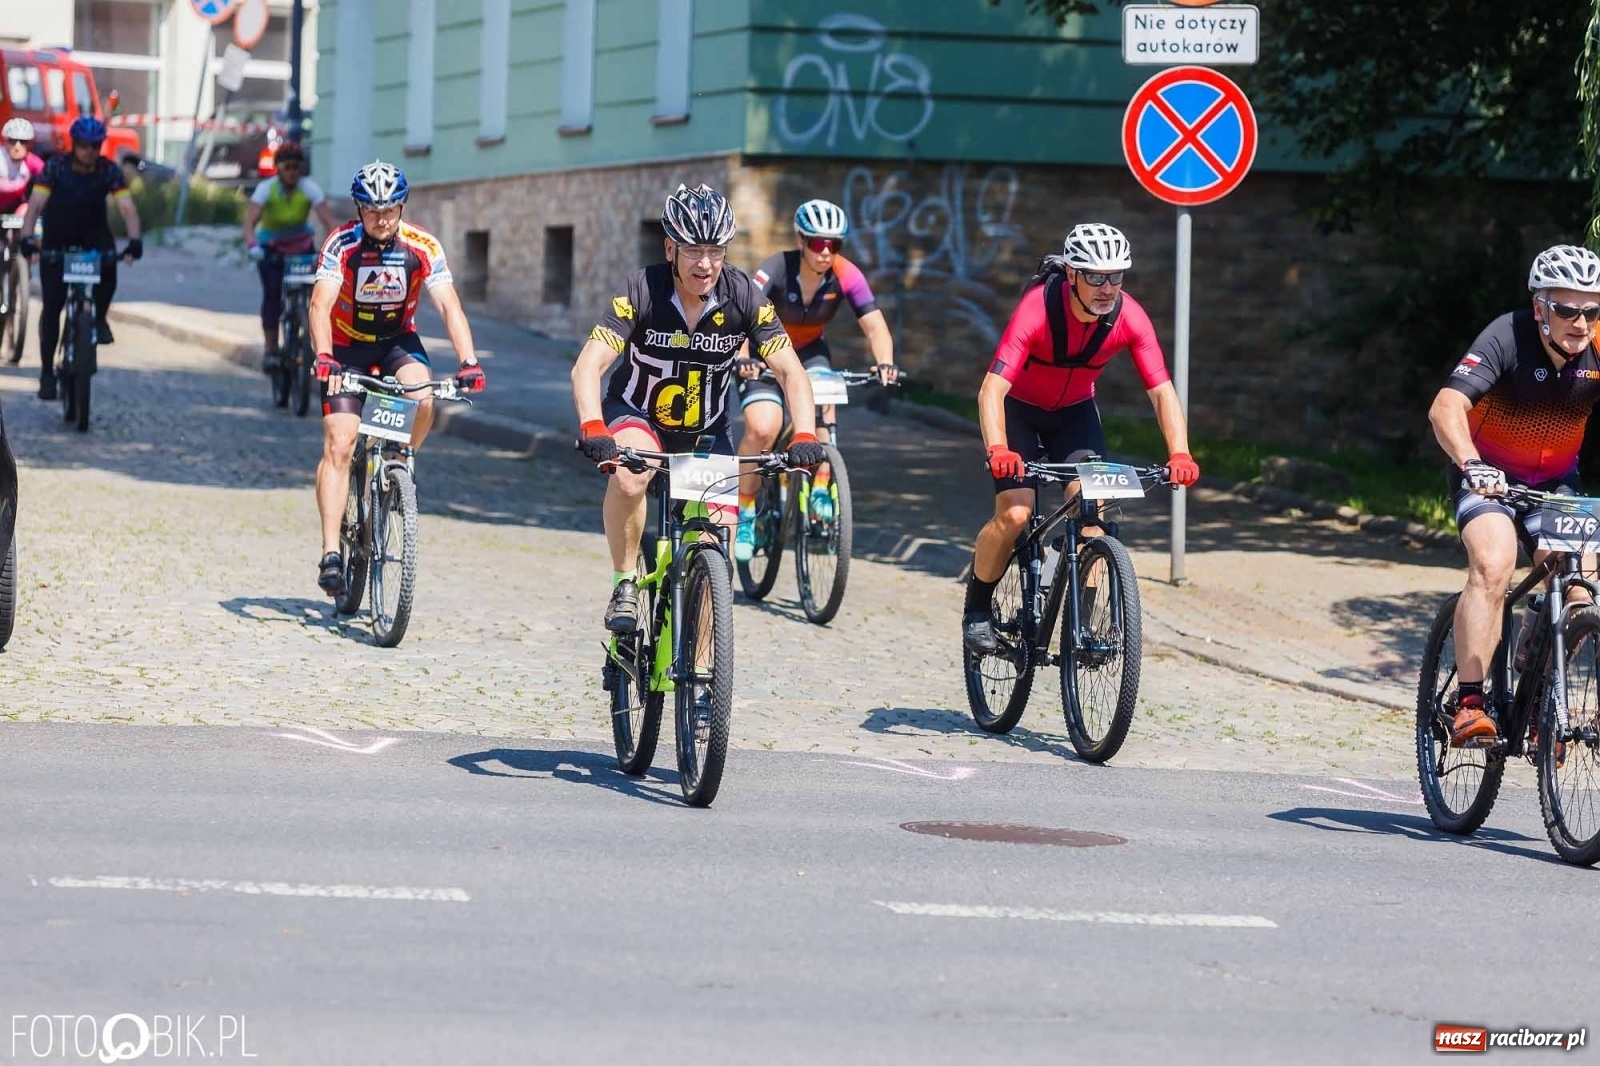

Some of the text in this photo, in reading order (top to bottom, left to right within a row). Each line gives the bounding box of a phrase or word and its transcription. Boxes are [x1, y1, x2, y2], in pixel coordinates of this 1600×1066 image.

[1134, 13, 1247, 35] Nie dotyczy
[371, 408, 406, 428] 2015
[1091, 473, 1129, 486] 2176
[1554, 516, 1598, 536] 1276
